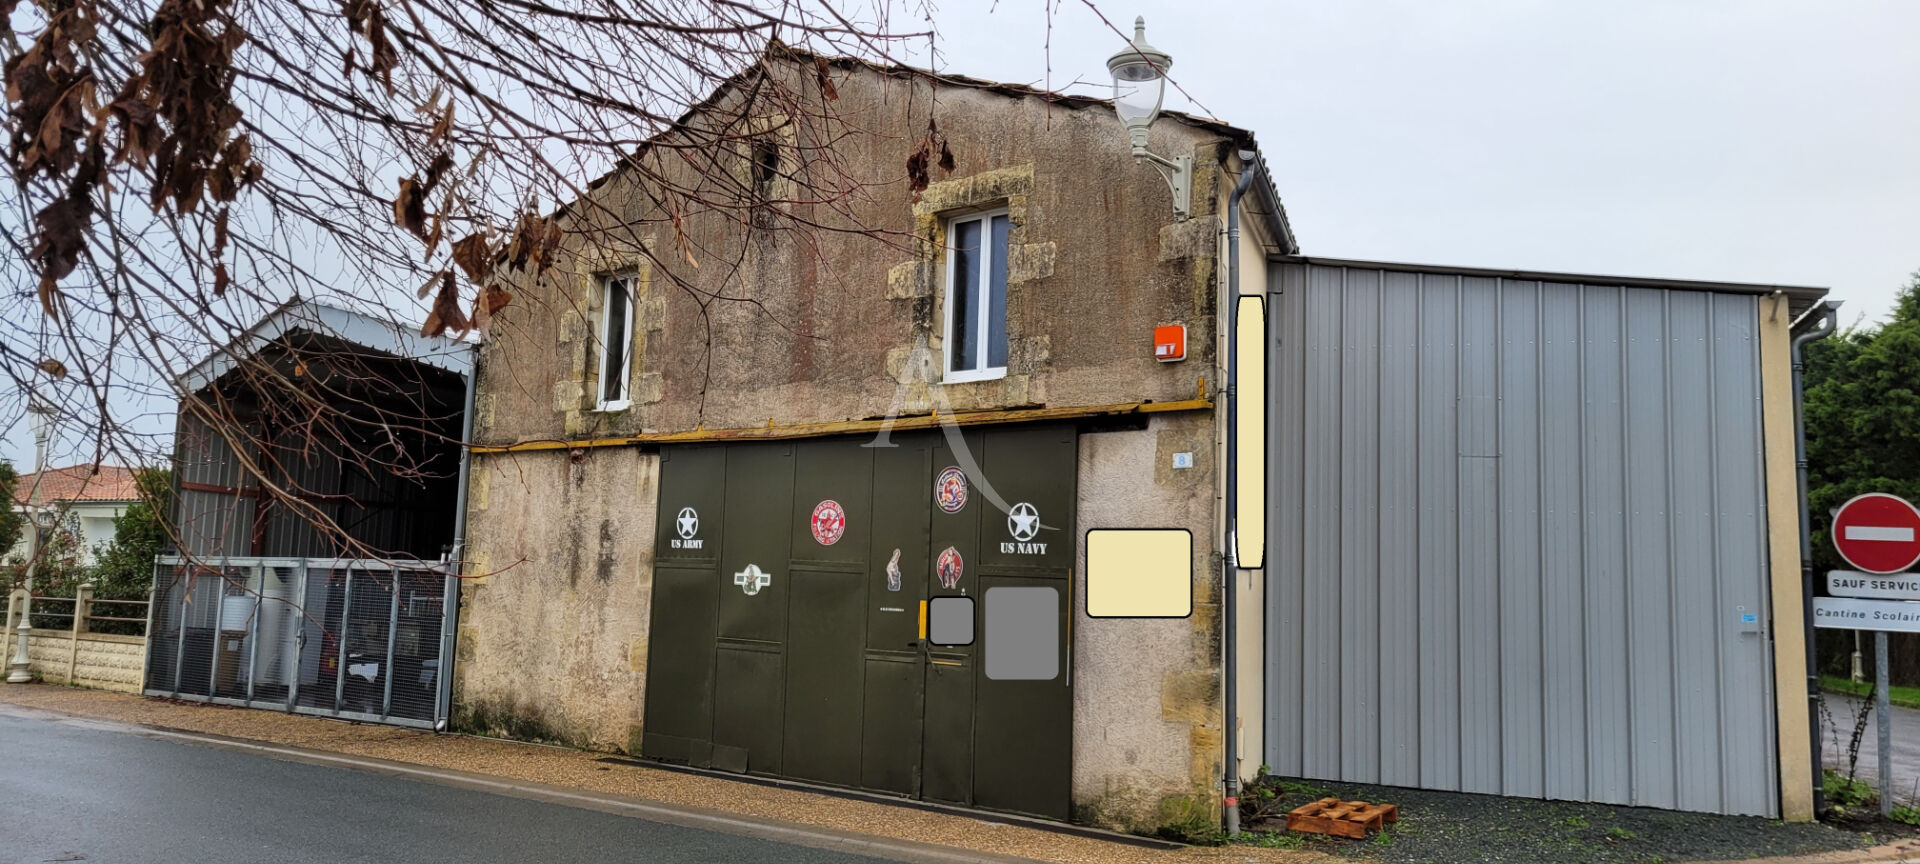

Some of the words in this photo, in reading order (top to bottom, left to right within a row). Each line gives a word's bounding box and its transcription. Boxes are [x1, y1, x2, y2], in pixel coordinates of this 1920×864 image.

[671, 539, 681, 549] US
[682, 539, 704, 549] ARMY
[1000, 542, 1015, 554] US
[1017, 542, 1047, 555] NAVY
[1832, 578, 1867, 589] SAUF
[1870, 580, 1920, 591] SERVIC
[1816, 608, 1866, 619] Cantine
